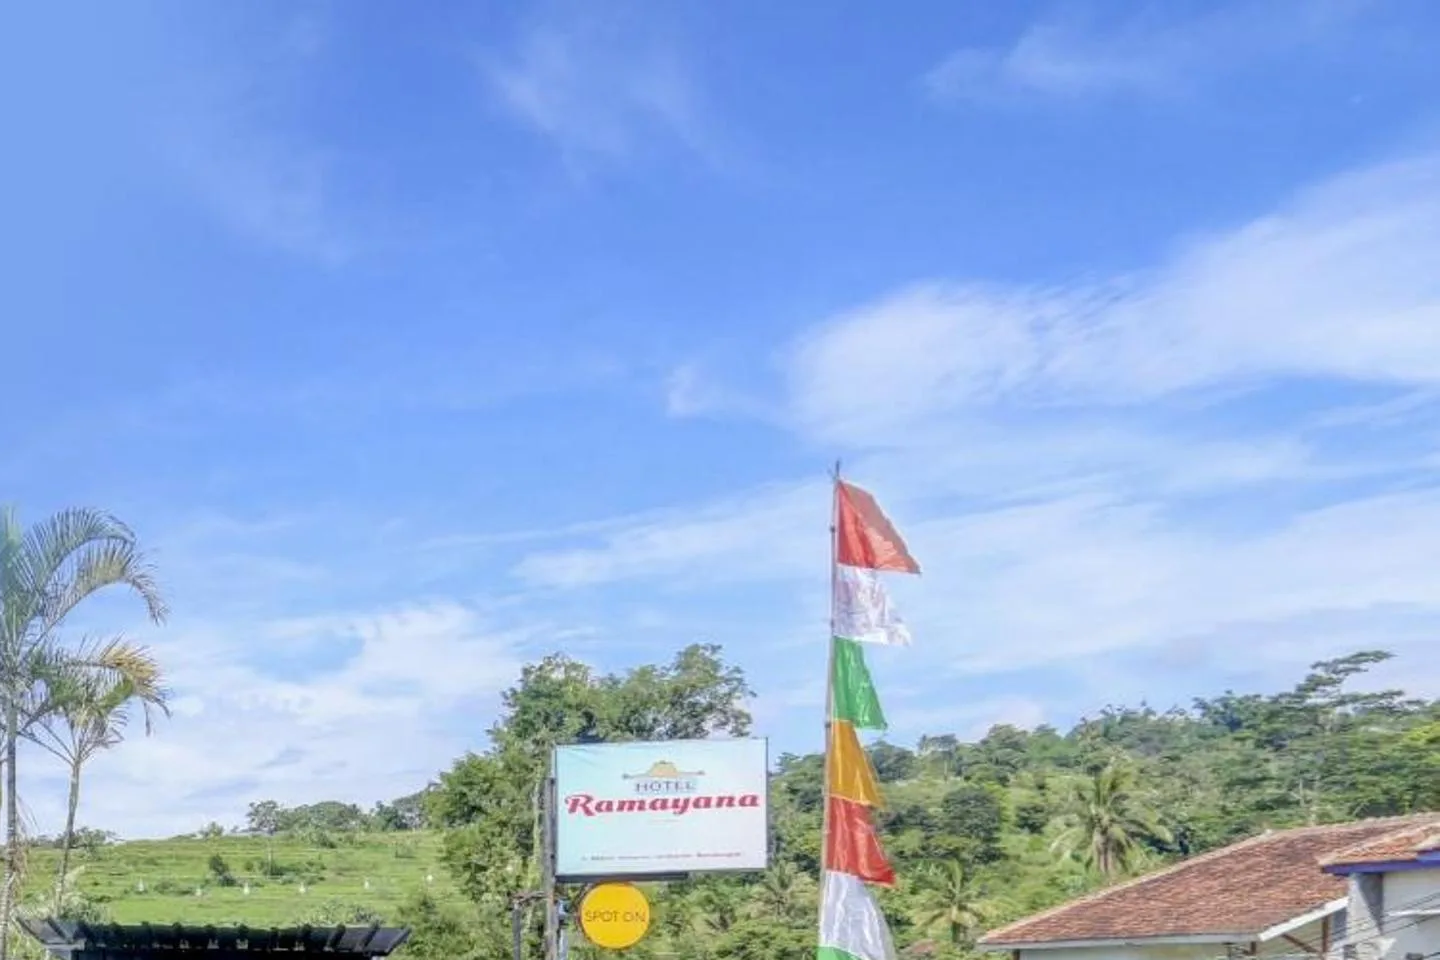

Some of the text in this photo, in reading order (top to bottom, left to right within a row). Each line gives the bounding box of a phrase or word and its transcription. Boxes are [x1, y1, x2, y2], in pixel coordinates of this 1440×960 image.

[635, 780, 696, 791] HOTEL
[565, 793, 760, 816] Ramayana
[585, 910, 646, 922] SPOT ON
